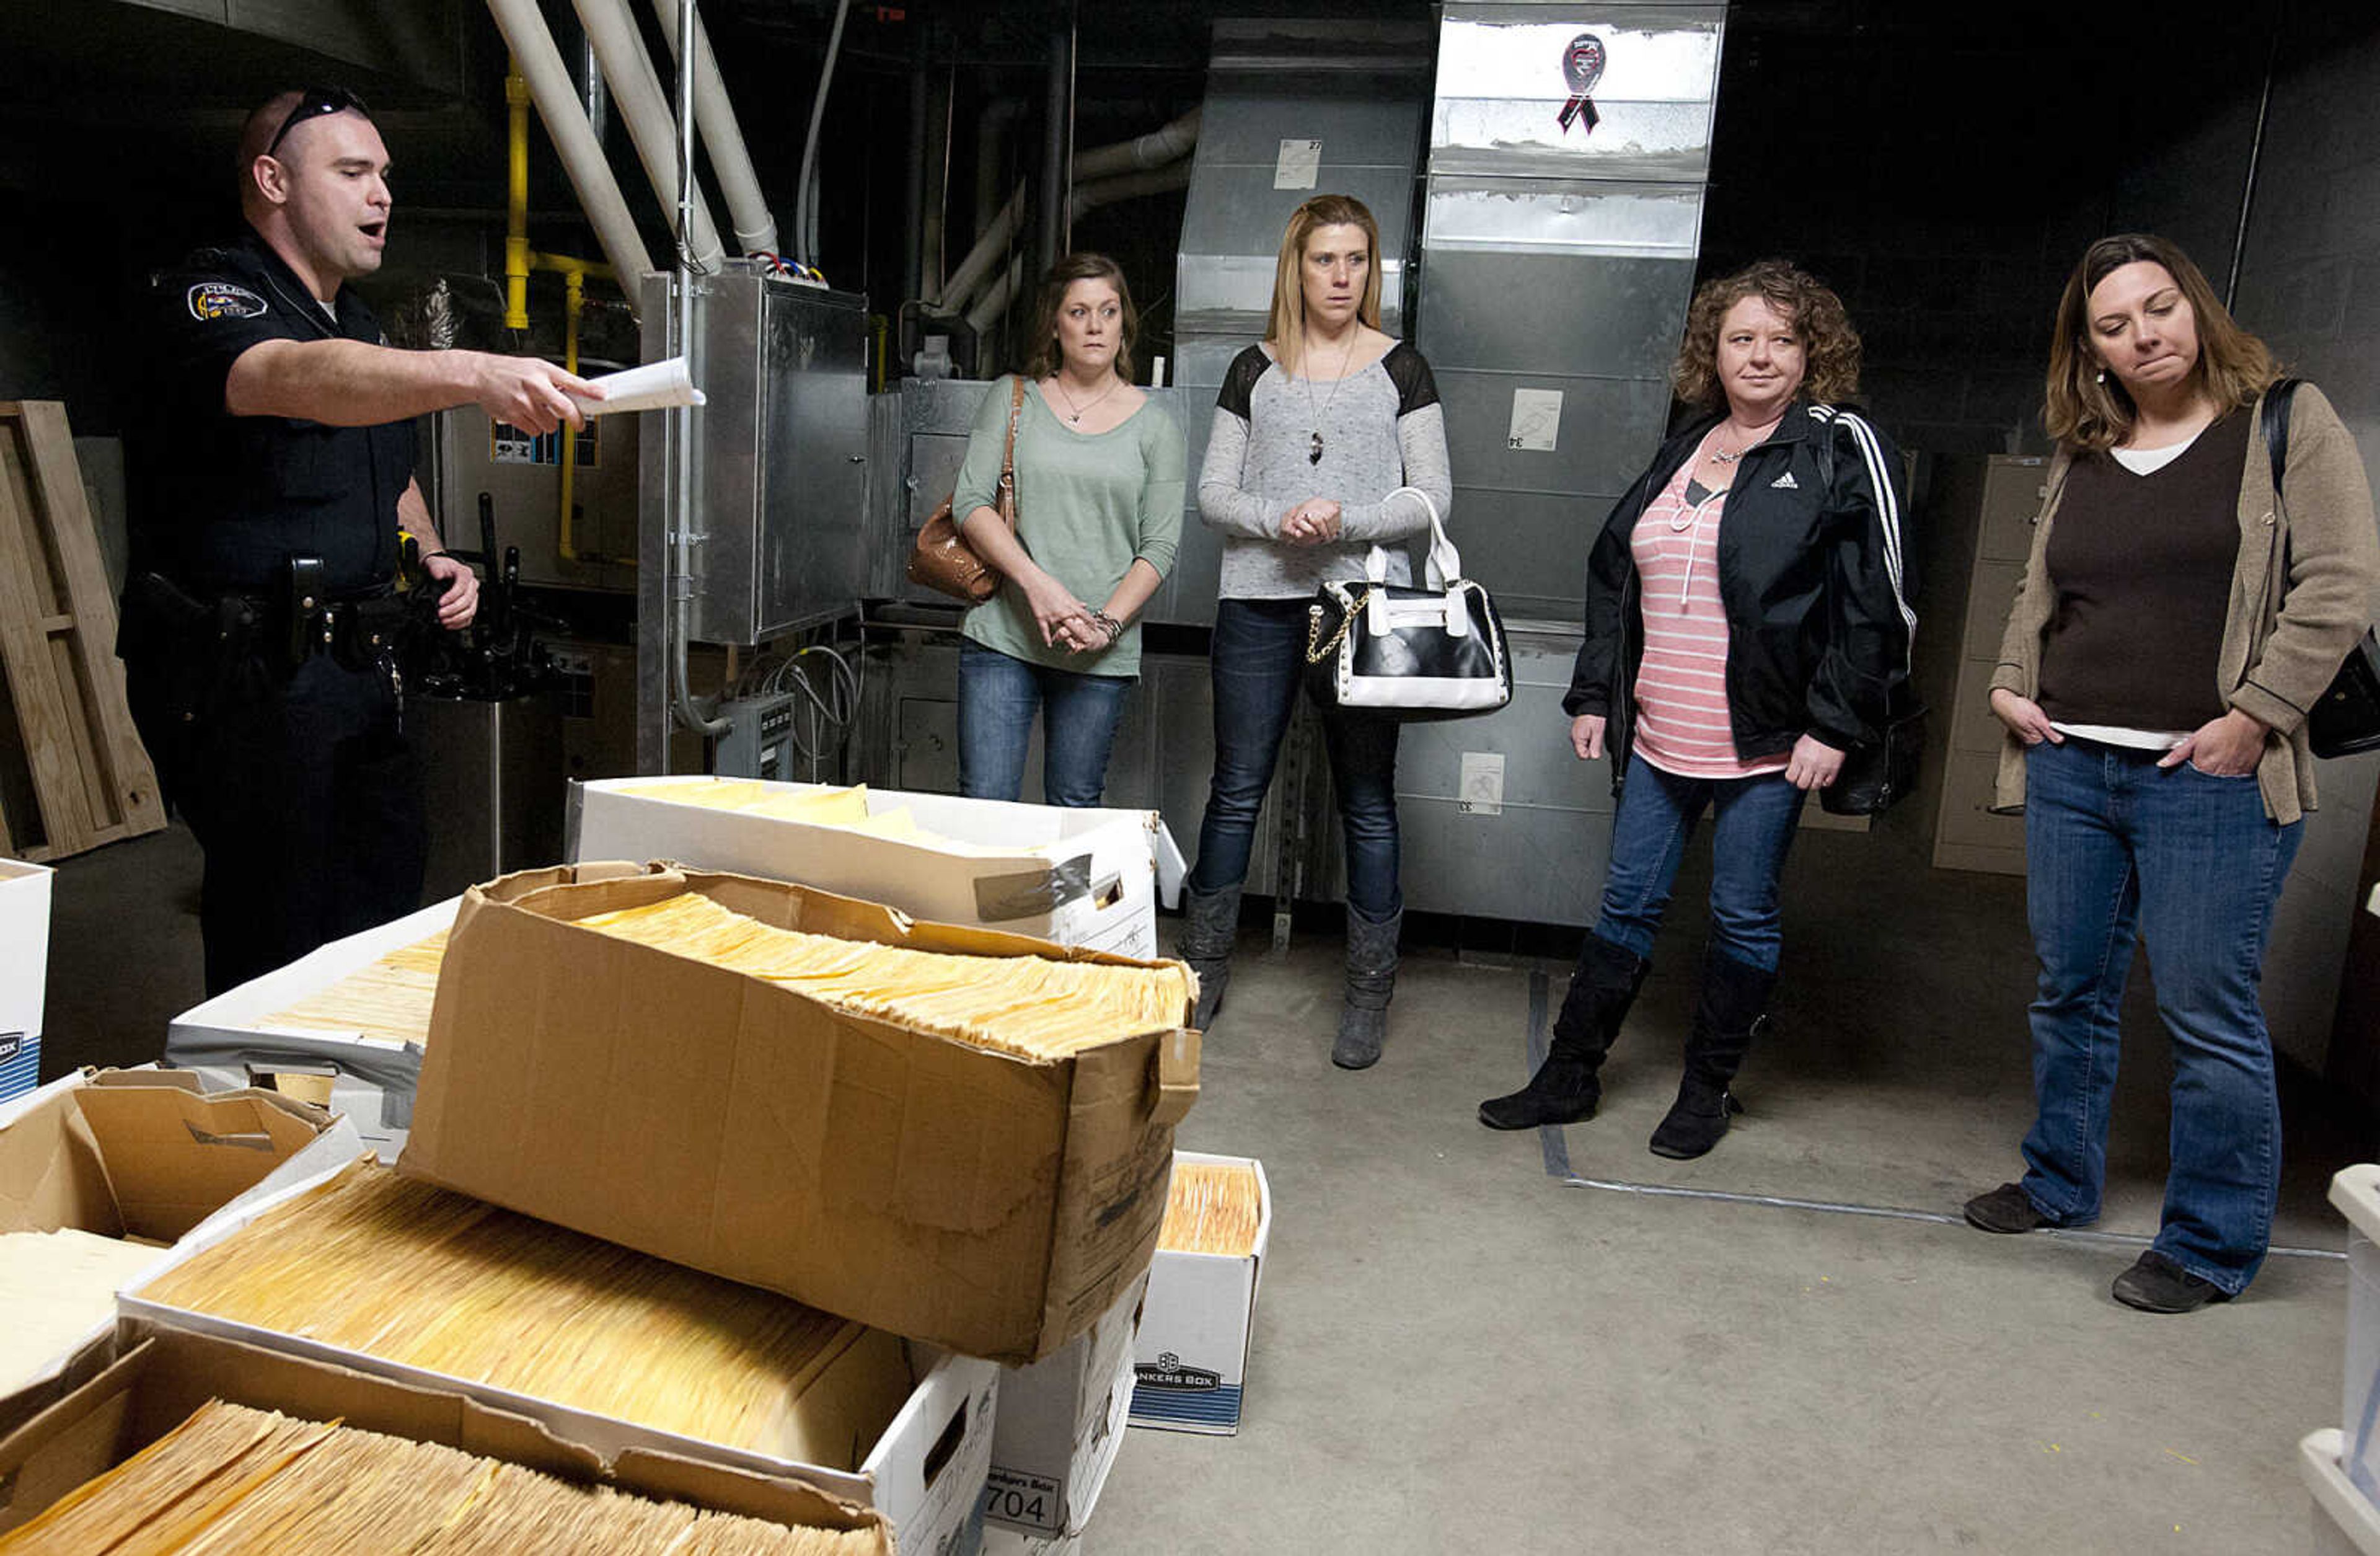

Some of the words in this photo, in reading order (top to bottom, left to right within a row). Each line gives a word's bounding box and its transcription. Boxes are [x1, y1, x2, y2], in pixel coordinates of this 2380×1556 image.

[1137, 1372, 1182, 1384] NKERS
[1185, 1375, 1213, 1386] BOX
[987, 1486, 1045, 1522] 704
